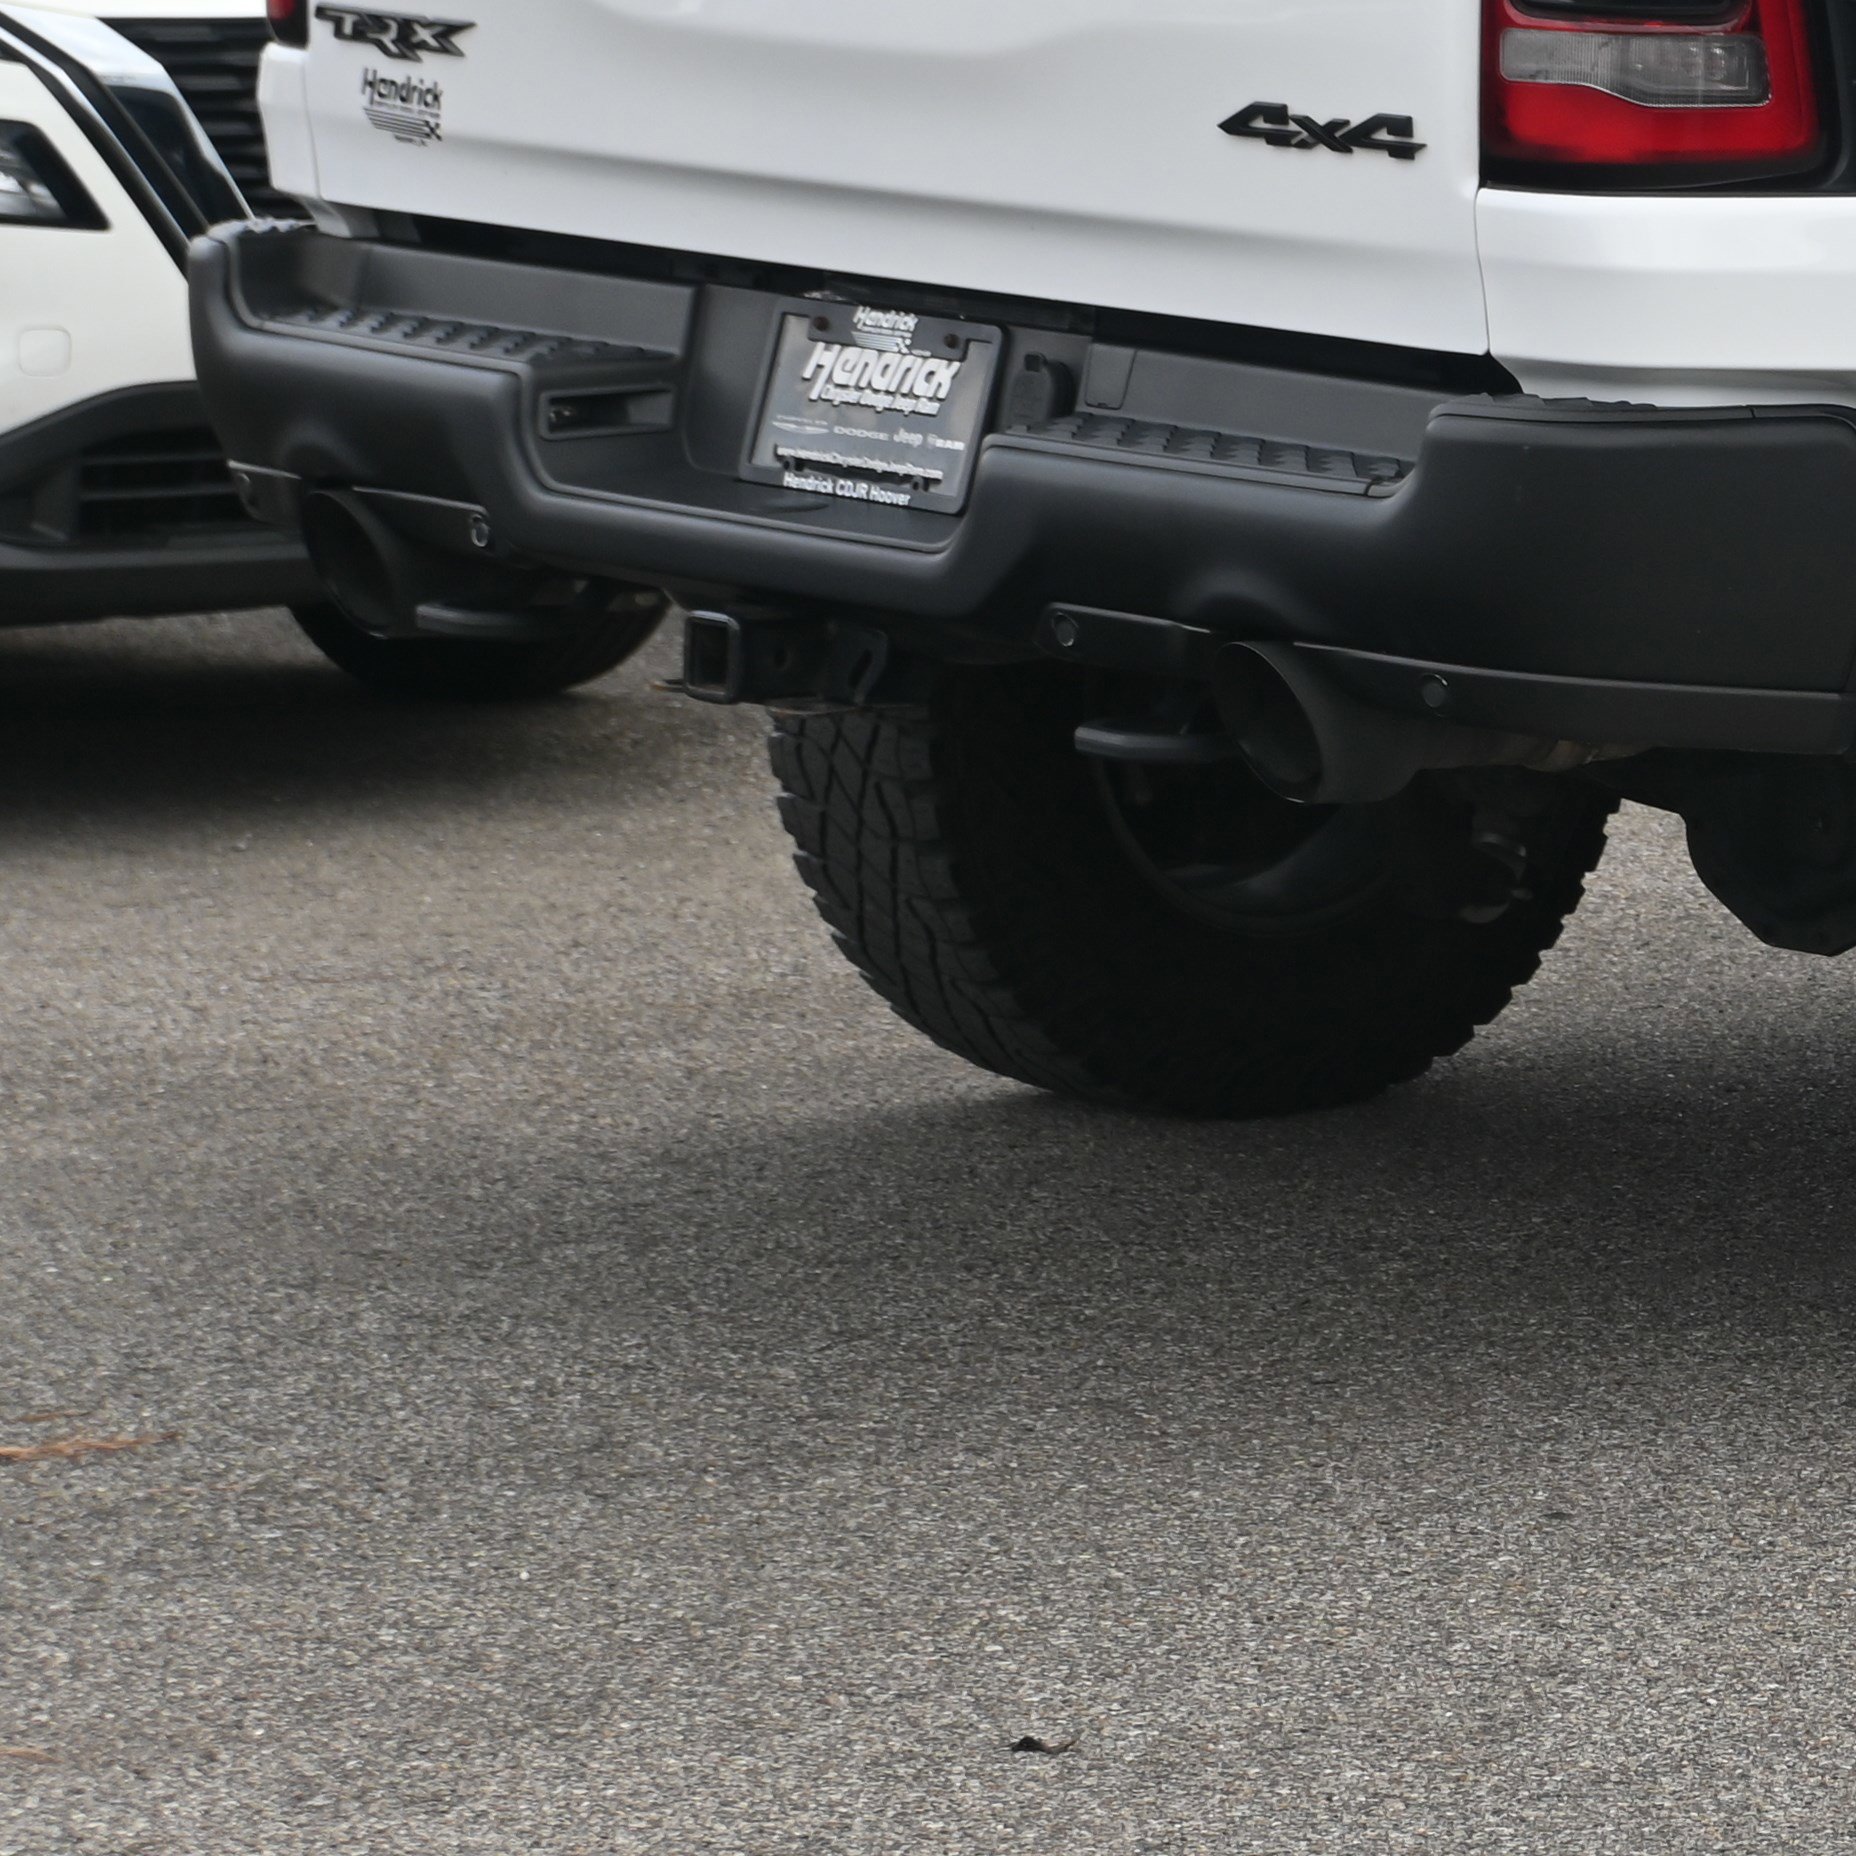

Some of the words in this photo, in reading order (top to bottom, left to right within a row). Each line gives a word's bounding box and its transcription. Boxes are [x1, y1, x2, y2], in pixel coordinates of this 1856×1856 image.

[314, 2, 477, 63] TRX
[361, 67, 444, 110] Hendrick
[1217, 100, 1428, 161] 4x4
[852, 305, 919, 332] Hendrick
[802, 342, 961, 401] Hendrick
[833, 425, 890, 442] DODGE
[893, 427, 924, 448] Jeep
[783, 471, 834, 494] Hendrick
[869, 484, 912, 506] Hoover
